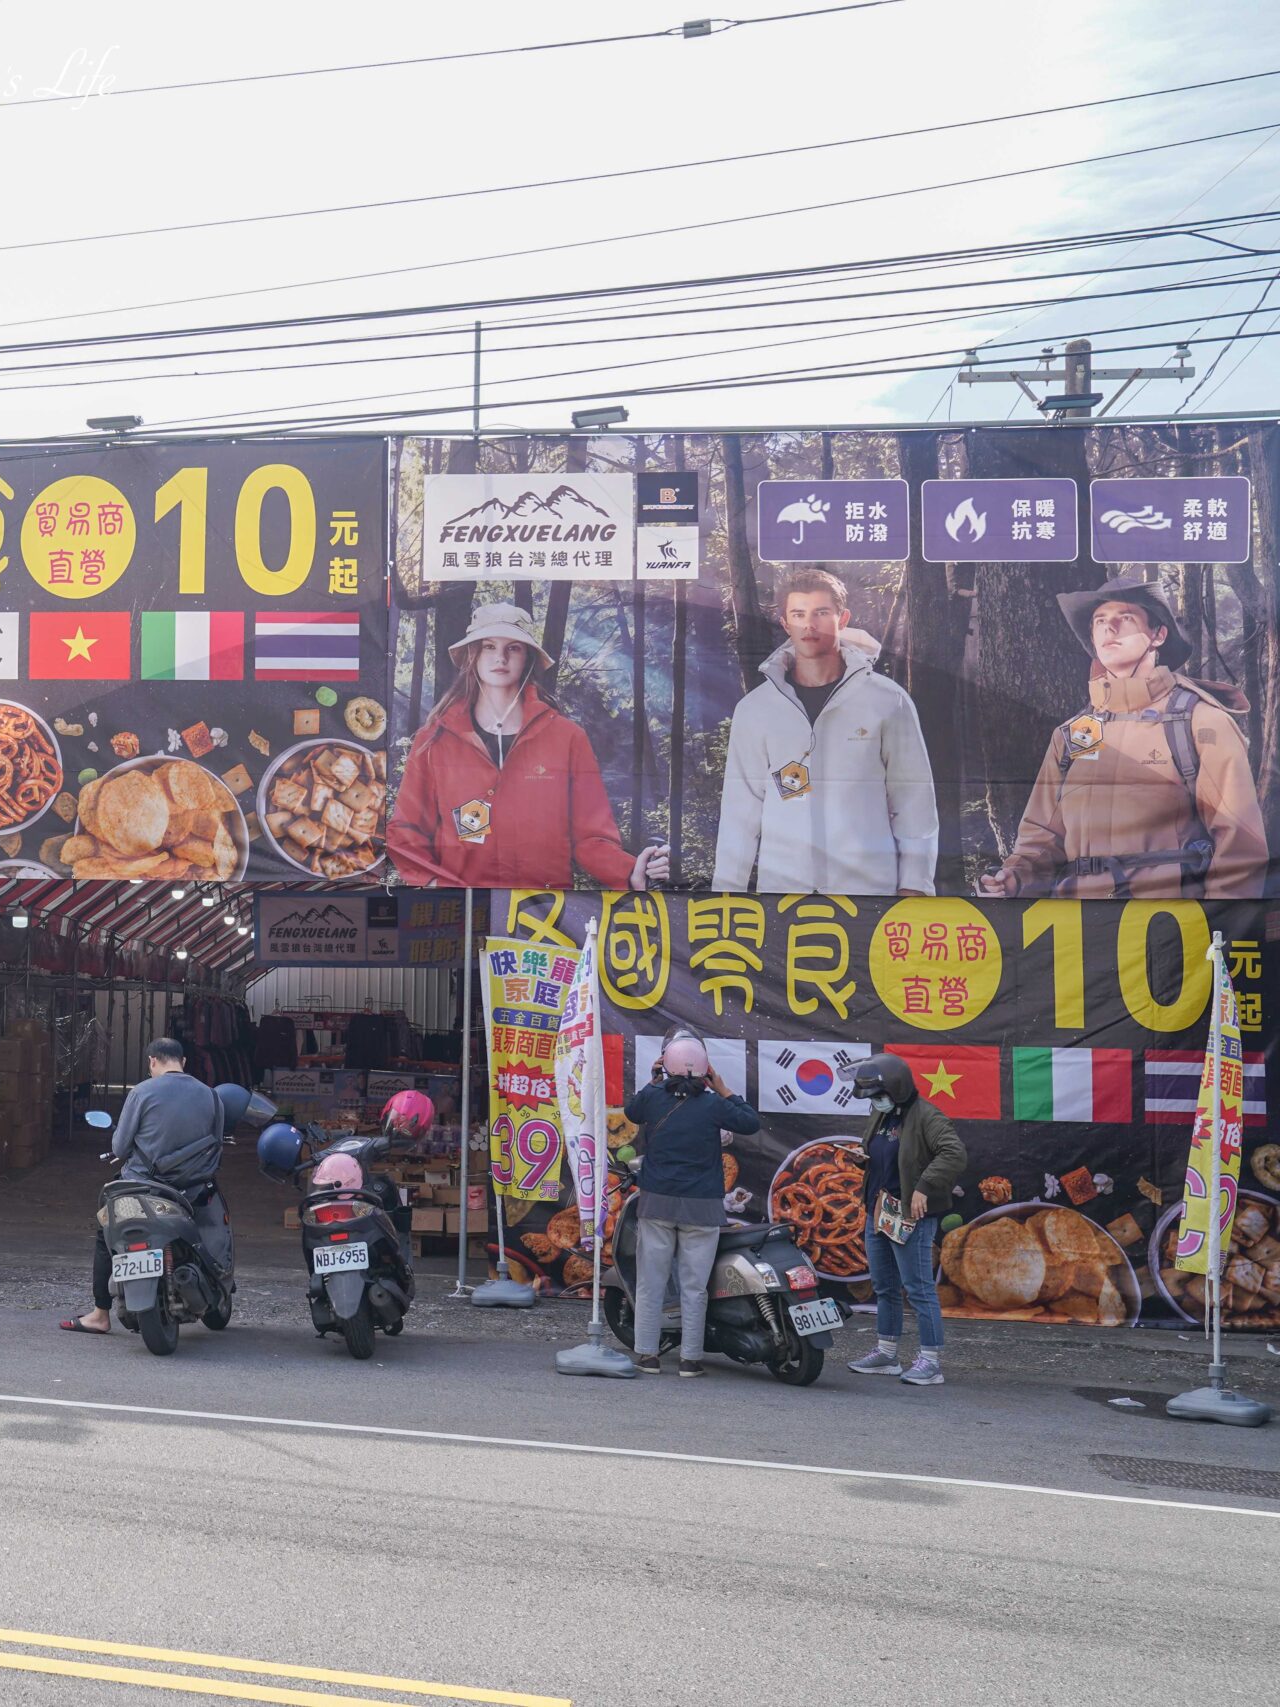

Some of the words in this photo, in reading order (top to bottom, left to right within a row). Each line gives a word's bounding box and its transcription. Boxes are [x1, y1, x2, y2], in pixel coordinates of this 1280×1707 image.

[844, 501, 889, 521] 拒水
[1011, 498, 1056, 518] 保暖
[1183, 497, 1228, 518] 柔軟
[34, 501, 125, 537] 貿易商
[155, 463, 318, 595] 10
[1011, 519, 1056, 541] 抗寒
[439, 523, 617, 543] FENGXUELANG
[844, 523, 889, 543] 防潑
[1183, 520, 1228, 542] 舒適
[47, 549, 108, 587] 直營
[441, 551, 613, 568] 風雪狼台灣總代理
[645, 560, 692, 570] YUANFA
[268, 926, 358, 939] FENGXUELANG
[884, 921, 987, 962] 貿易商
[490, 950, 578, 985] 快樂龍
[1022, 898, 1213, 1032] 10
[504, 978, 562, 1009] 家庭
[902, 975, 969, 1017] 直營
[491, 1113, 561, 1192] 39
[540, 1179, 560, 1199] 元
